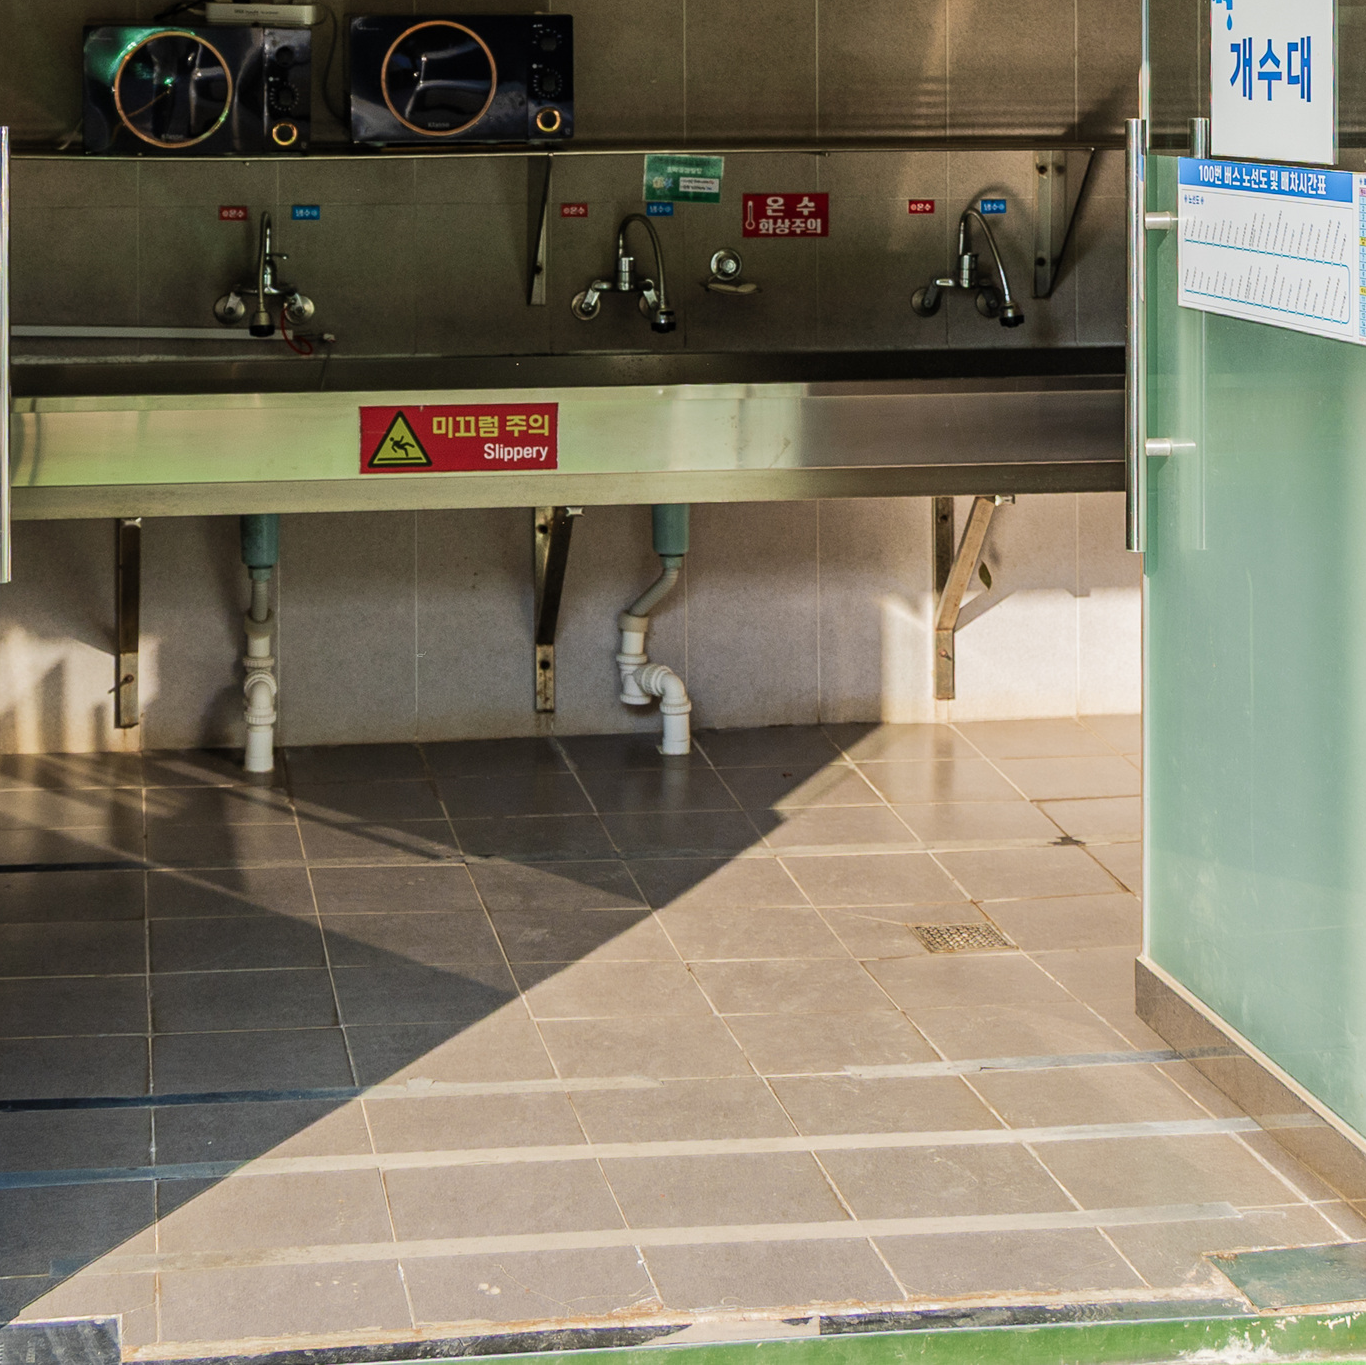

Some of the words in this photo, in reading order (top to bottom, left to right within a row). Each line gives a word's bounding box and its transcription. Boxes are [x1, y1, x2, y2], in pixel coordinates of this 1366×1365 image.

[1228, 34, 1312, 103] 개수대
[1198, 164, 1223, 184] 100번
[1224, 166, 1241, 186] 버스
[1242, 167, 1268, 189] 노선도
[1270, 170, 1278, 190] 및
[1280, 171, 1327, 195] 배차시간표
[758, 217, 823, 235] 화상주의
[432, 414, 499, 438] 미끄럼
[506, 413, 549, 437] 주의
[483, 443, 549, 462] Slippery
